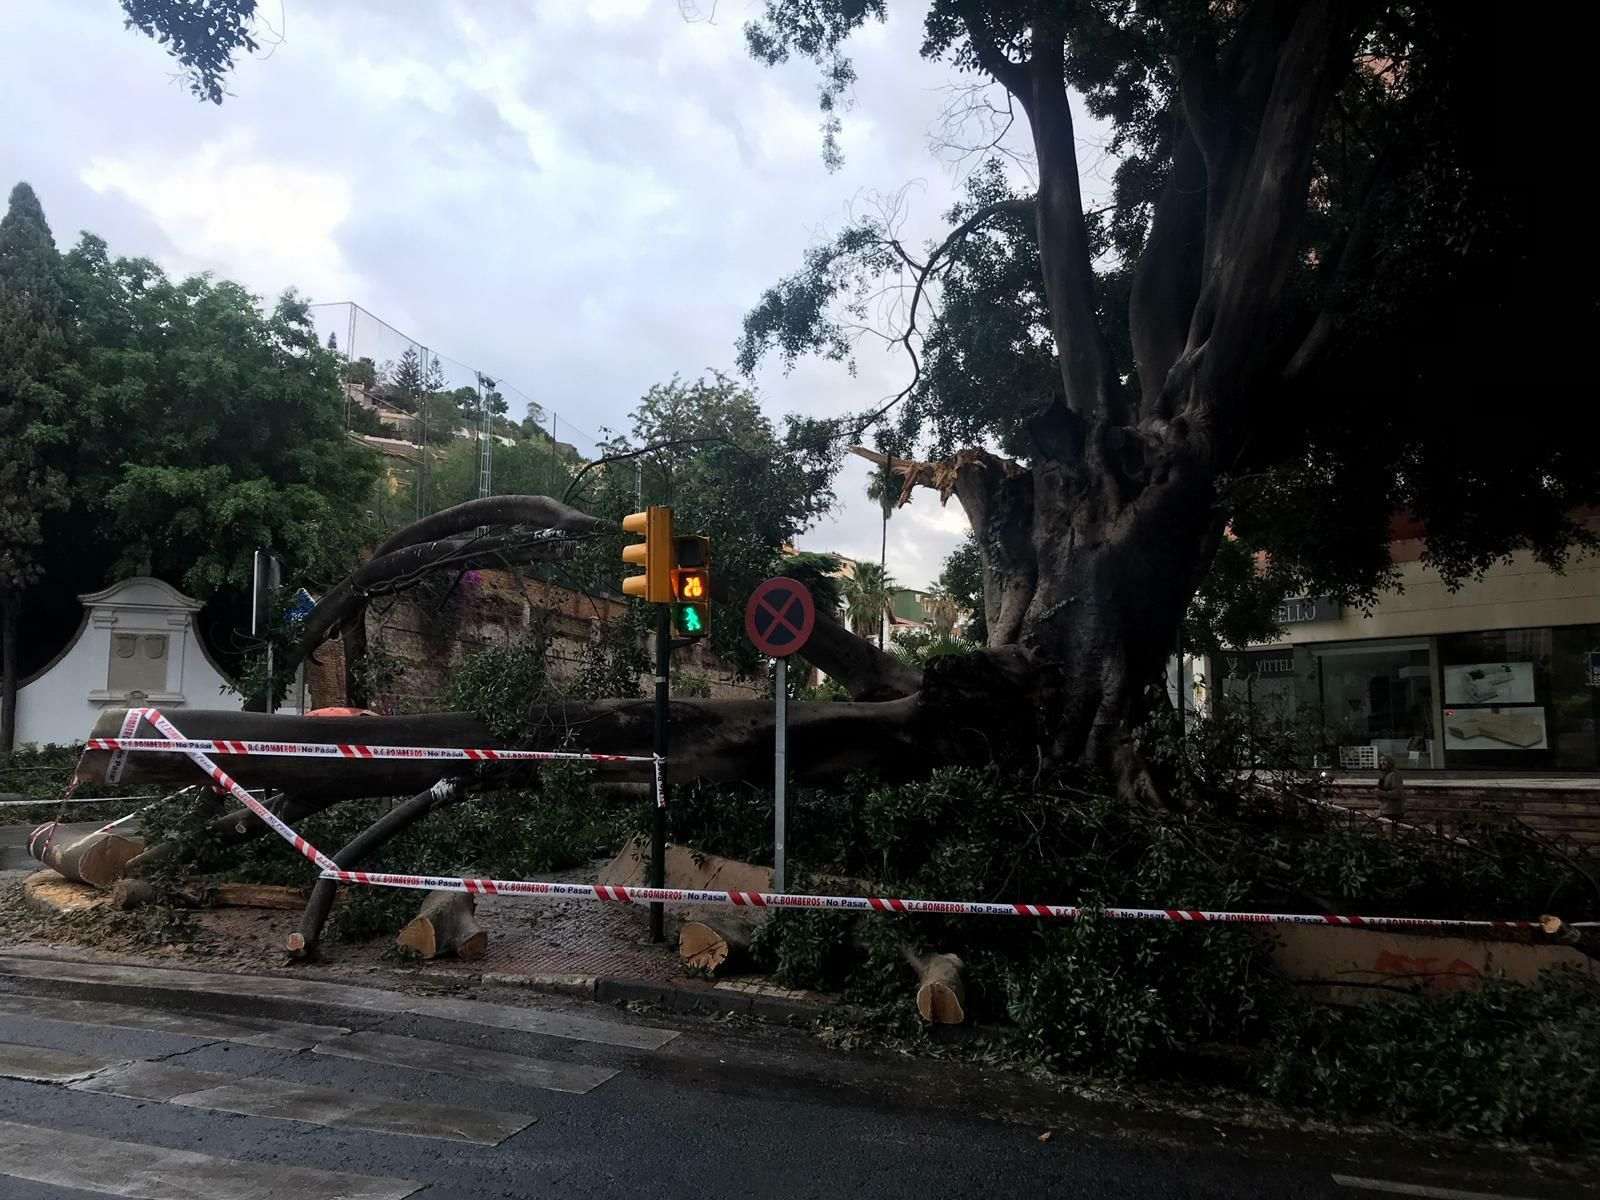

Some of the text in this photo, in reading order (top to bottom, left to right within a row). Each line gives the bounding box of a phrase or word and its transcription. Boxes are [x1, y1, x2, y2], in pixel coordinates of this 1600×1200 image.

[1278, 604, 1316, 623] ELLO
[315, 746, 338, 754] Pasar
[438, 879, 462, 887] Pasar
[567, 887, 592, 895] Pasar
[629, 889, 682, 900] R.C.BOMBEROS
[687, 892, 699, 900] No
[702, 893, 727, 901] Pasar
[766, 896, 821, 906] R.C.BOMBEROS
[841, 900, 867, 908] Pasar
[908, 902, 965, 912] R.C.BOMBEROS
[1137, 912, 1165, 920] Pasar
[1293, 916, 1323, 925] Pasar
